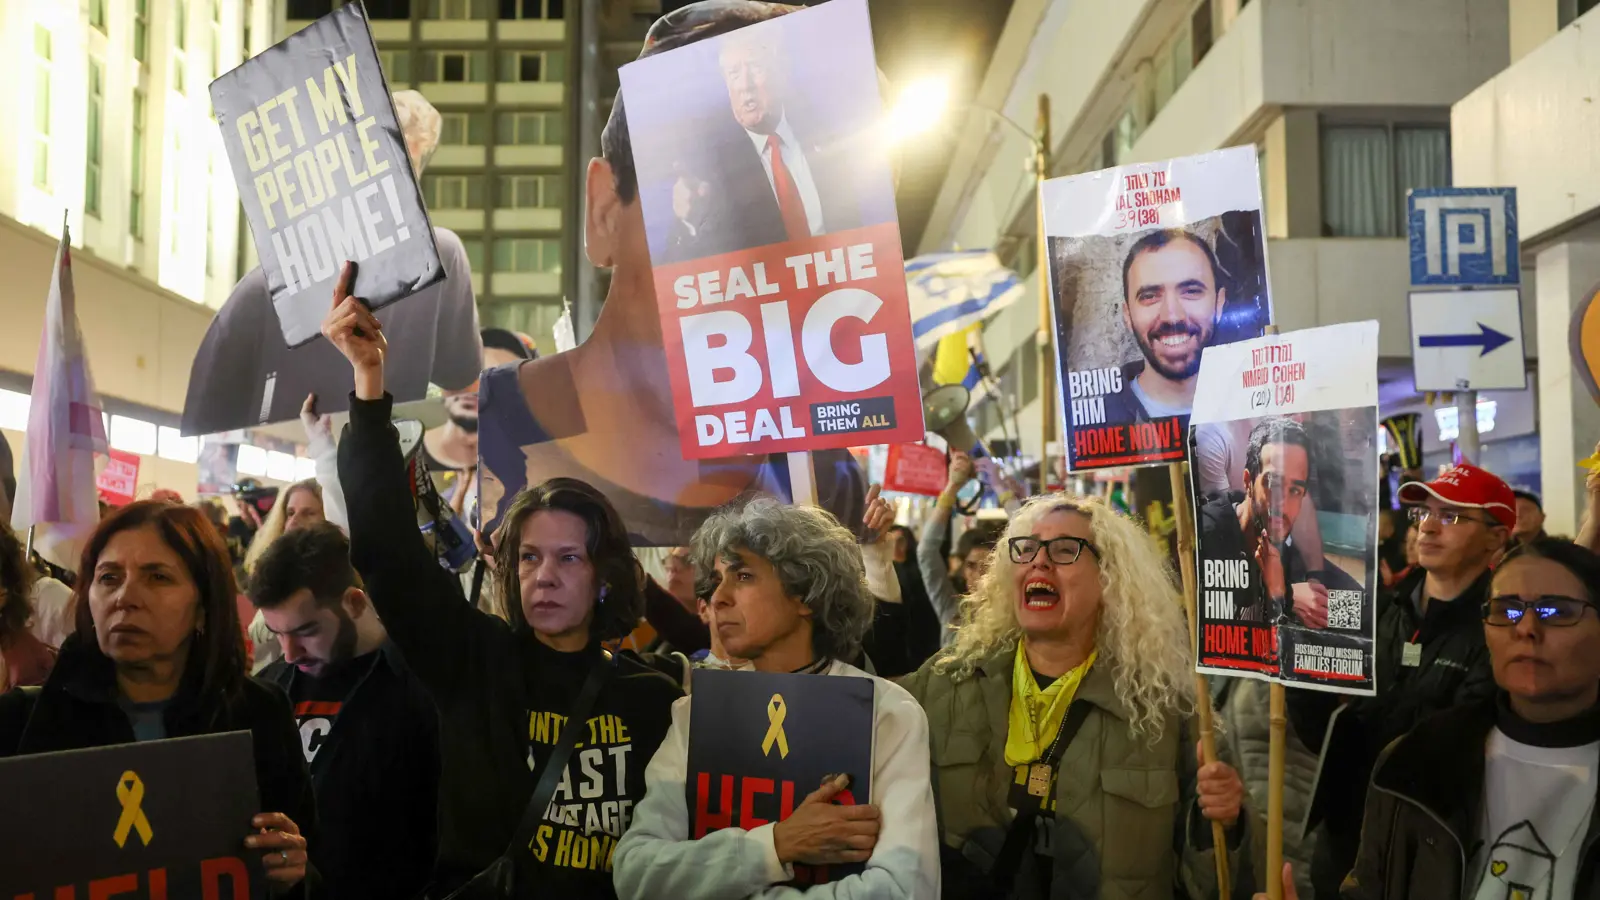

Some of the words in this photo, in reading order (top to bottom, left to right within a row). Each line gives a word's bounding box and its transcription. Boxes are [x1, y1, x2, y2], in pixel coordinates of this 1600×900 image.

[236, 86, 307, 172] GET
[305, 53, 365, 135] MY
[253, 115, 390, 230] PEOPLE
[1134, 187, 1181, 208] SHOHAM
[271, 174, 411, 297] HOME!
[1114, 210, 1136, 230] 39
[673, 262, 780, 310] SEAL
[785, 243, 877, 289] THE
[679, 288, 891, 407] BIG
[1069, 366, 1123, 398] BRING
[1272, 362, 1306, 383] COHEN
[695, 406, 806, 446] DEAL
[816, 403, 861, 419] BRING
[817, 418, 858, 432] THEM
[861, 414, 890, 428] ALL
[1072, 397, 1106, 426] HIM
[1075, 426, 1126, 457] HOME
[1128, 417, 1181, 451] NOW!
[1204, 559, 1249, 589] BRING
[1204, 590, 1234, 620] HIM
[1204, 624, 1249, 655] HOME
[1294, 643, 1323, 657] HOSTAGES
[1323, 646, 1336, 657] AND
[1336, 647, 1363, 660] MISSING
[1294, 654, 1330, 673] FAMILIES
[1331, 658, 1363, 677] FORUM
[585, 714, 632, 745] THE
[528, 825, 553, 863] S
[554, 829, 619, 872] HOM
